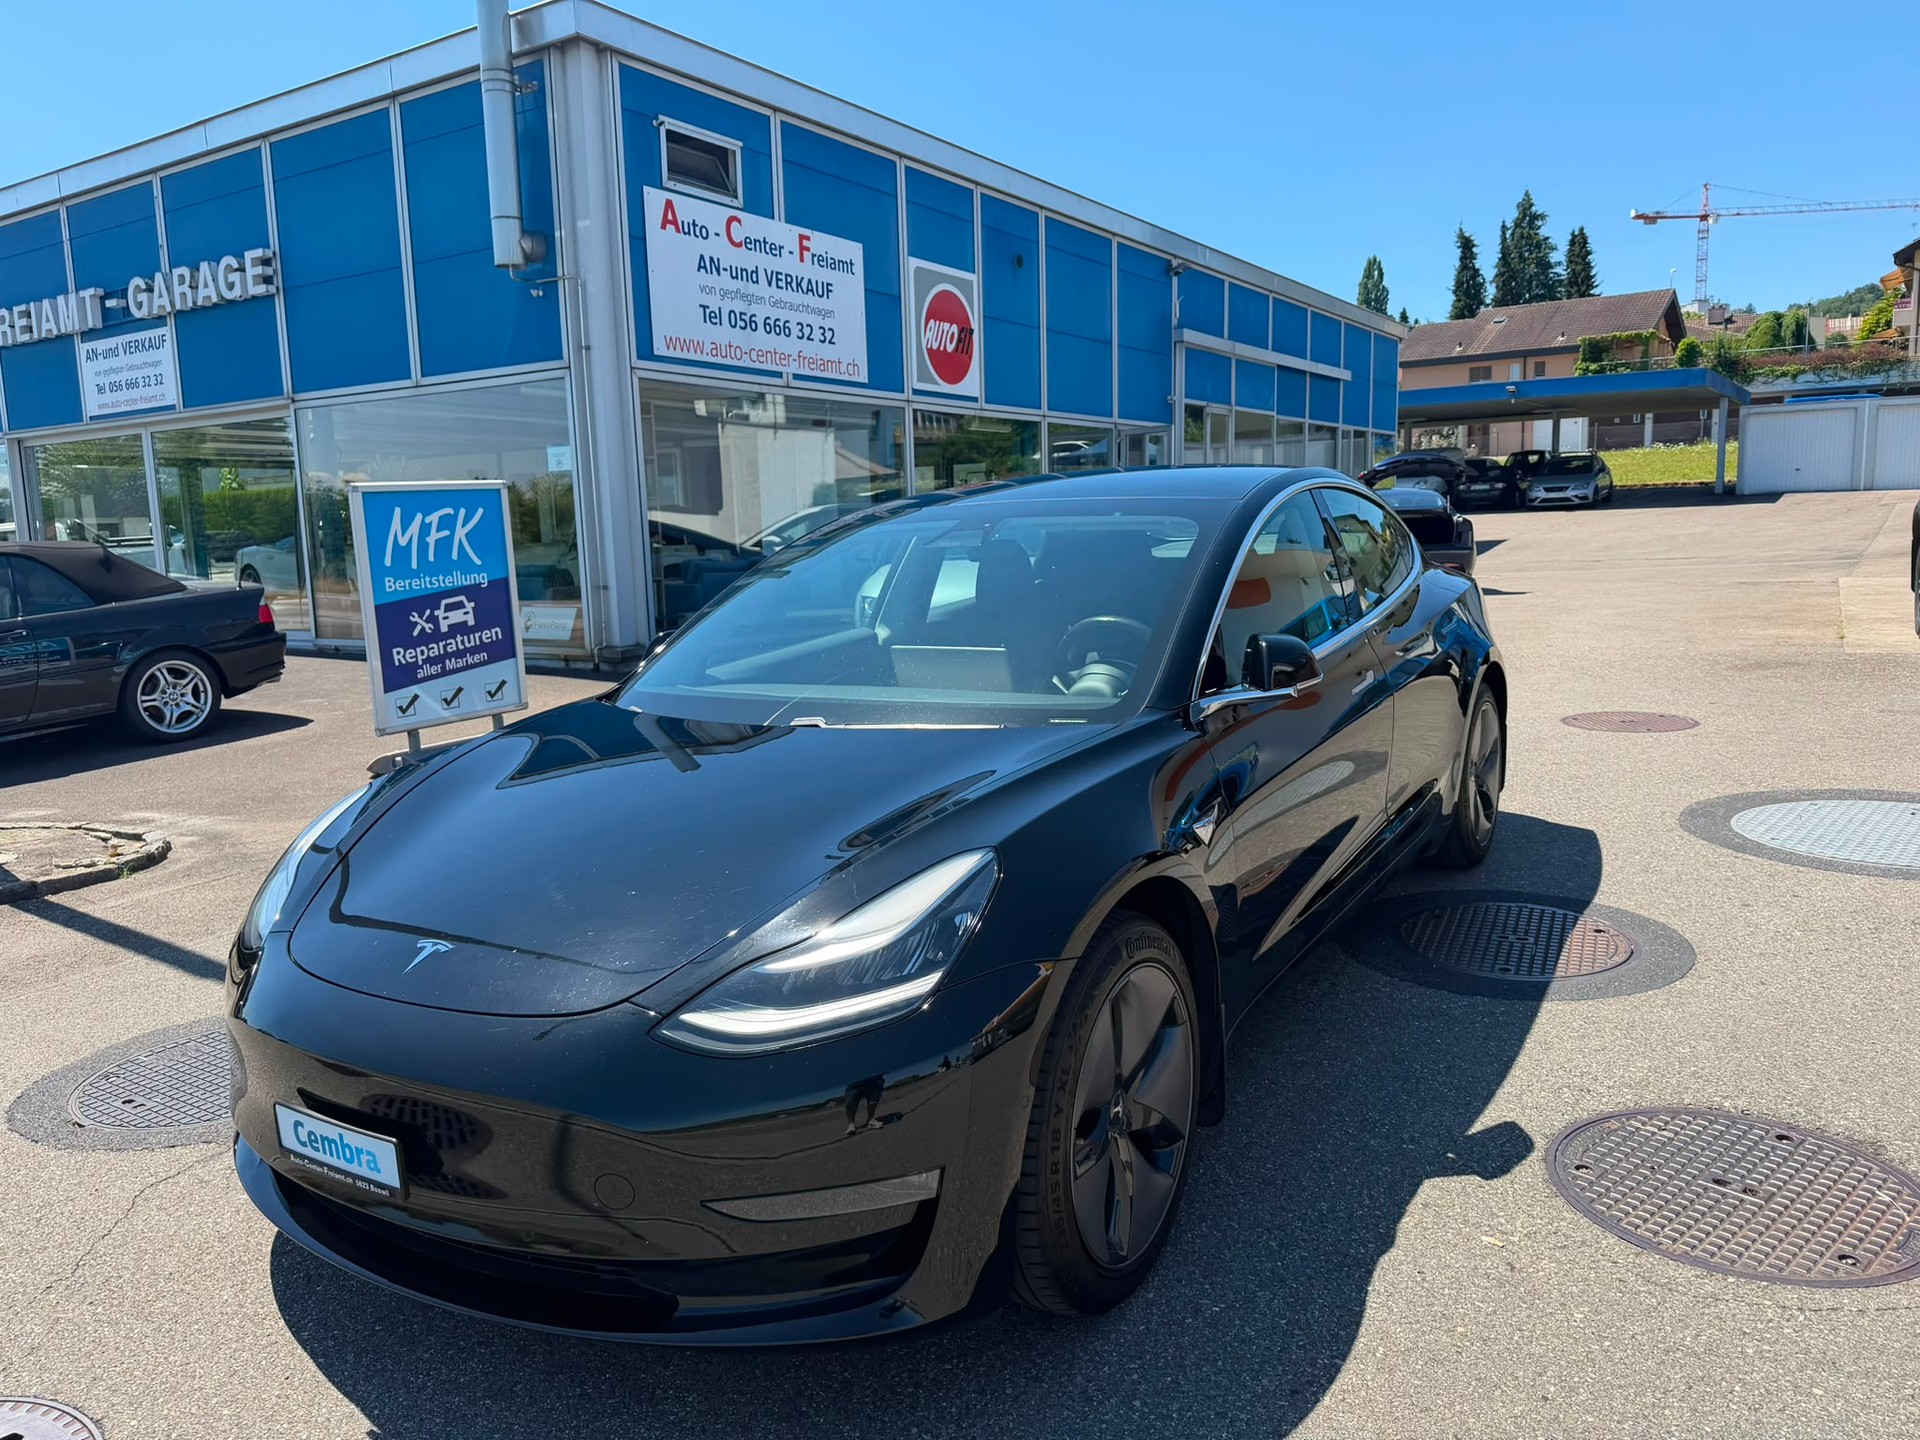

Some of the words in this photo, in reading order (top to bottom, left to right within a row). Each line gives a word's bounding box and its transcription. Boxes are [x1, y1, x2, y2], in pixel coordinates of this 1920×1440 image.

[660, 198, 709, 241] Auto
[725, 215, 784, 259] Center
[798, 233, 855, 276] Freiamt
[127, 247, 278, 319] GARAGE
[697, 254, 760, 286] AN-und
[764, 267, 834, 300] VERKAUF
[699, 283, 716, 297] von
[719, 287, 765, 306] gepflegten
[768, 295, 835, 320] Gebrauchtwagen
[699, 304, 723, 327] Tel
[728, 310, 758, 332] 056
[763, 317, 792, 338] 666
[796, 322, 815, 343] 32
[818, 327, 836, 345] 32
[86, 343, 119, 363] AN-und
[121, 334, 167, 356] VERKAUF
[664, 335, 860, 378] www.auto-center-freiamt.ch
[95, 382, 106, 395] Tel
[108, 380, 123, 393] 056
[125, 377, 139, 391] 666
[141, 375, 152, 388] 32
[153, 373, 164, 387] 32
[384, 506, 484, 569] MFK
[384, 571, 488, 593] Bereitstellung
[392, 626, 502, 666] Reparaturen
[416, 662, 442, 679] aller
[446, 651, 488, 671] Marken
[1126, 931, 1171, 959] Continental
[293, 1119, 382, 1174] Cembra
